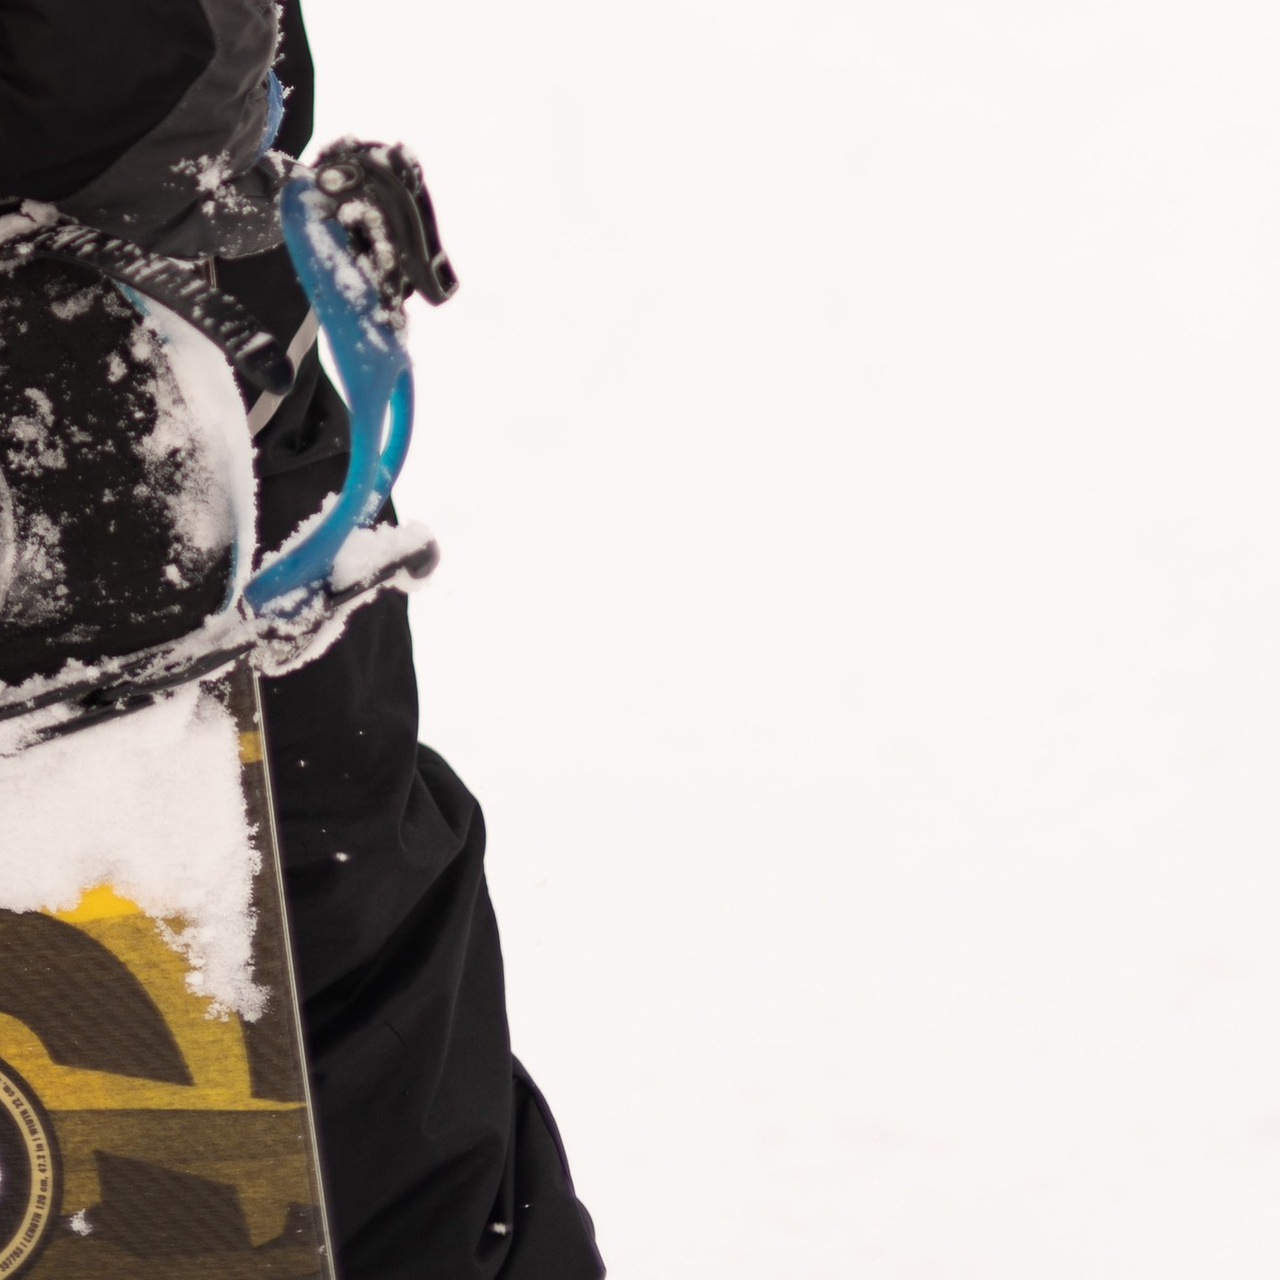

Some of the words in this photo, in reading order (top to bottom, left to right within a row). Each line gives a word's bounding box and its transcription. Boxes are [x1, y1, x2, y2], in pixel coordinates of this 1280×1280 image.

[12, 1097, 24, 1109] 22
[20, 1108, 39, 1137] WIDTH
[35, 1194, 47, 1210] 120
[23, 1212, 42, 1243] LENGTH
